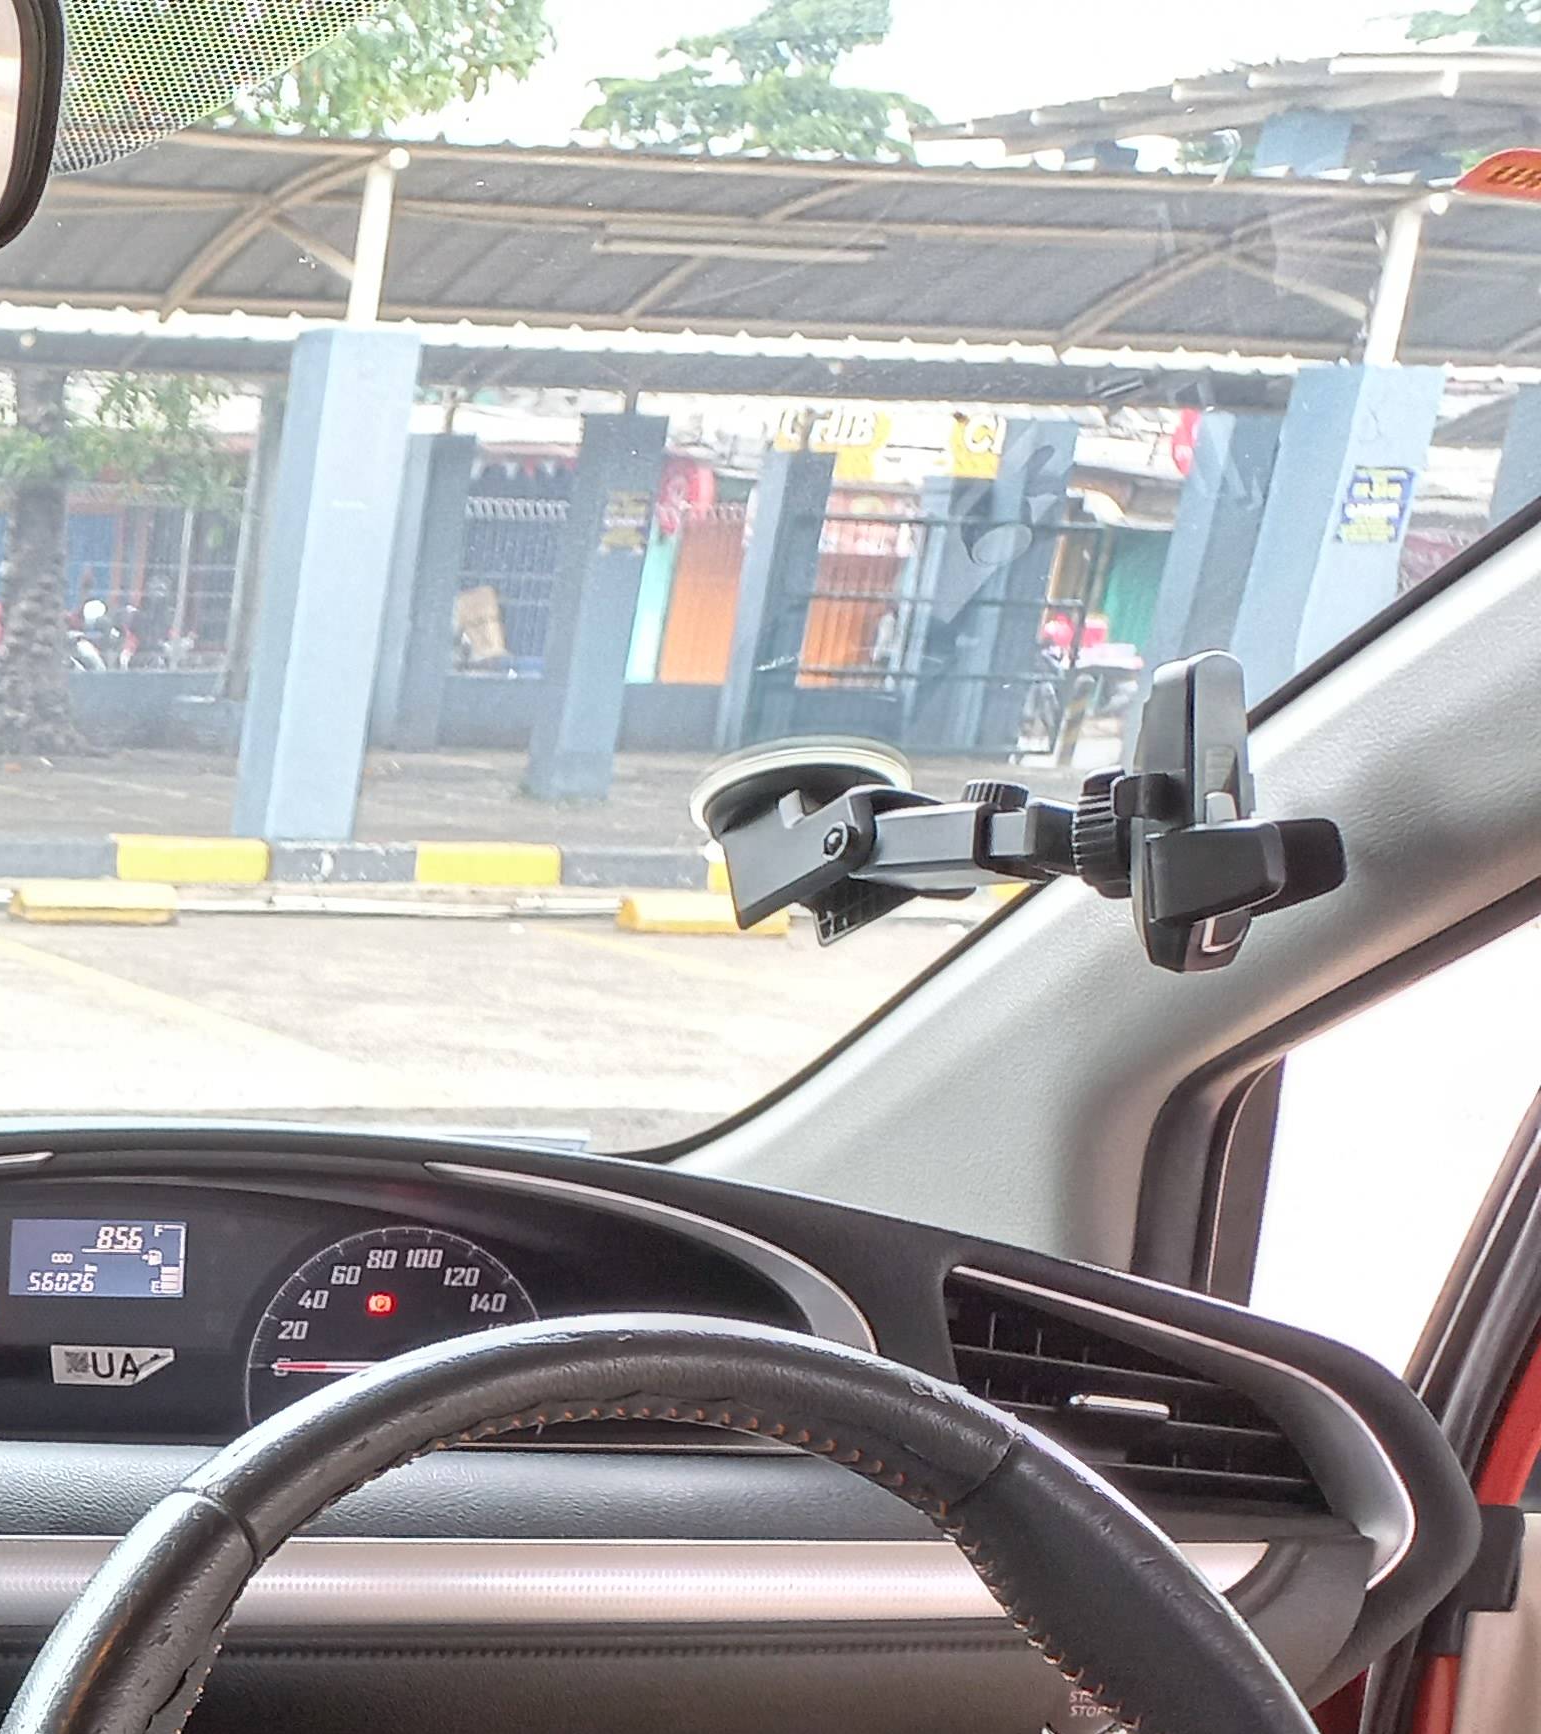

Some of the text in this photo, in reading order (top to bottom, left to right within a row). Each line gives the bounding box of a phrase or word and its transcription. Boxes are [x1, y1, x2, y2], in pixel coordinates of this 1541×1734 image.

[96, 1226, 144, 1250] 856
[154, 1224, 165, 1238] F
[366, 1249, 398, 1270] 80
[404, 1248, 444, 1269] 100
[26, 1271, 96, 1293] 56026
[330, 1265, 362, 1286] 60
[442, 1266, 481, 1287] 120
[297, 1289, 330, 1310] 40
[469, 1293, 508, 1313] 140
[277, 1320, 310, 1341] 20
